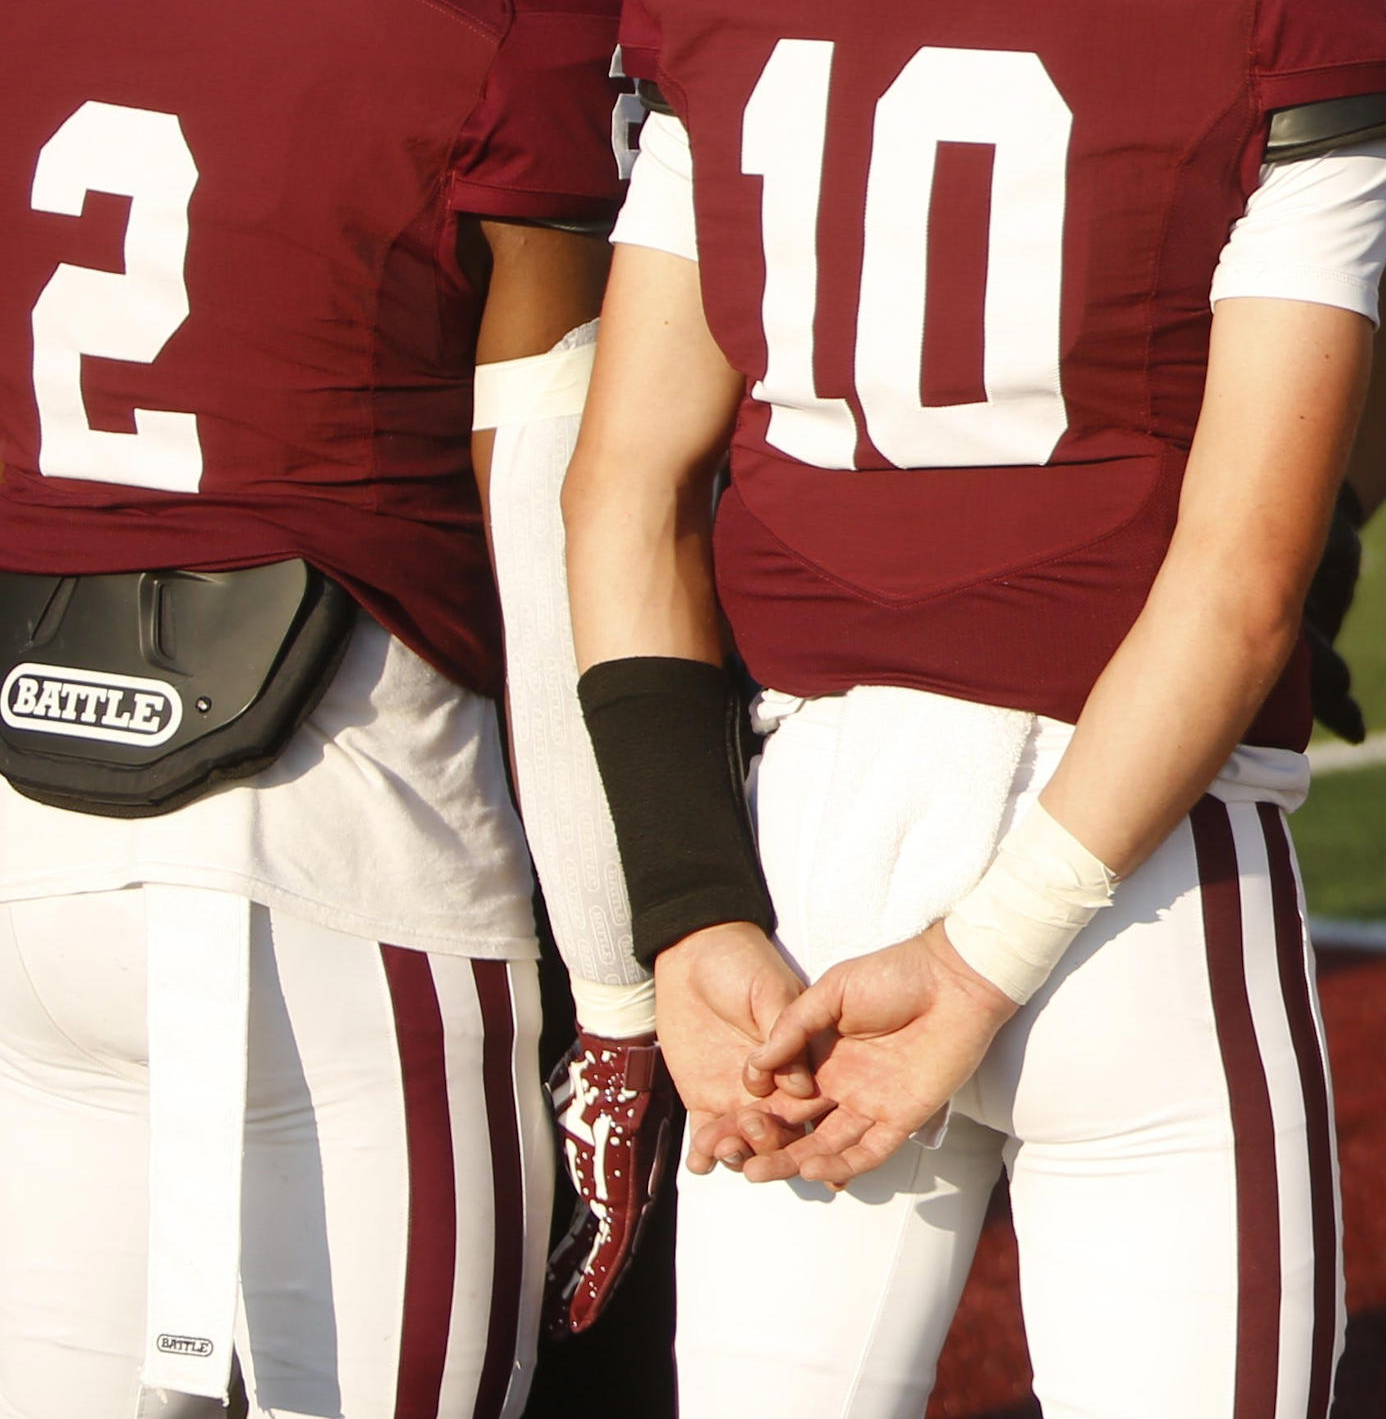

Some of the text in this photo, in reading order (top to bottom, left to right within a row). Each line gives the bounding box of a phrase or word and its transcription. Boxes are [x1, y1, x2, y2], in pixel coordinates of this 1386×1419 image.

[30, 99, 202, 494] 2
[740, 38, 1074, 471] 10
[12, 677, 165, 733] BATTLE
[161, 1337, 209, 1353] BATTLE
